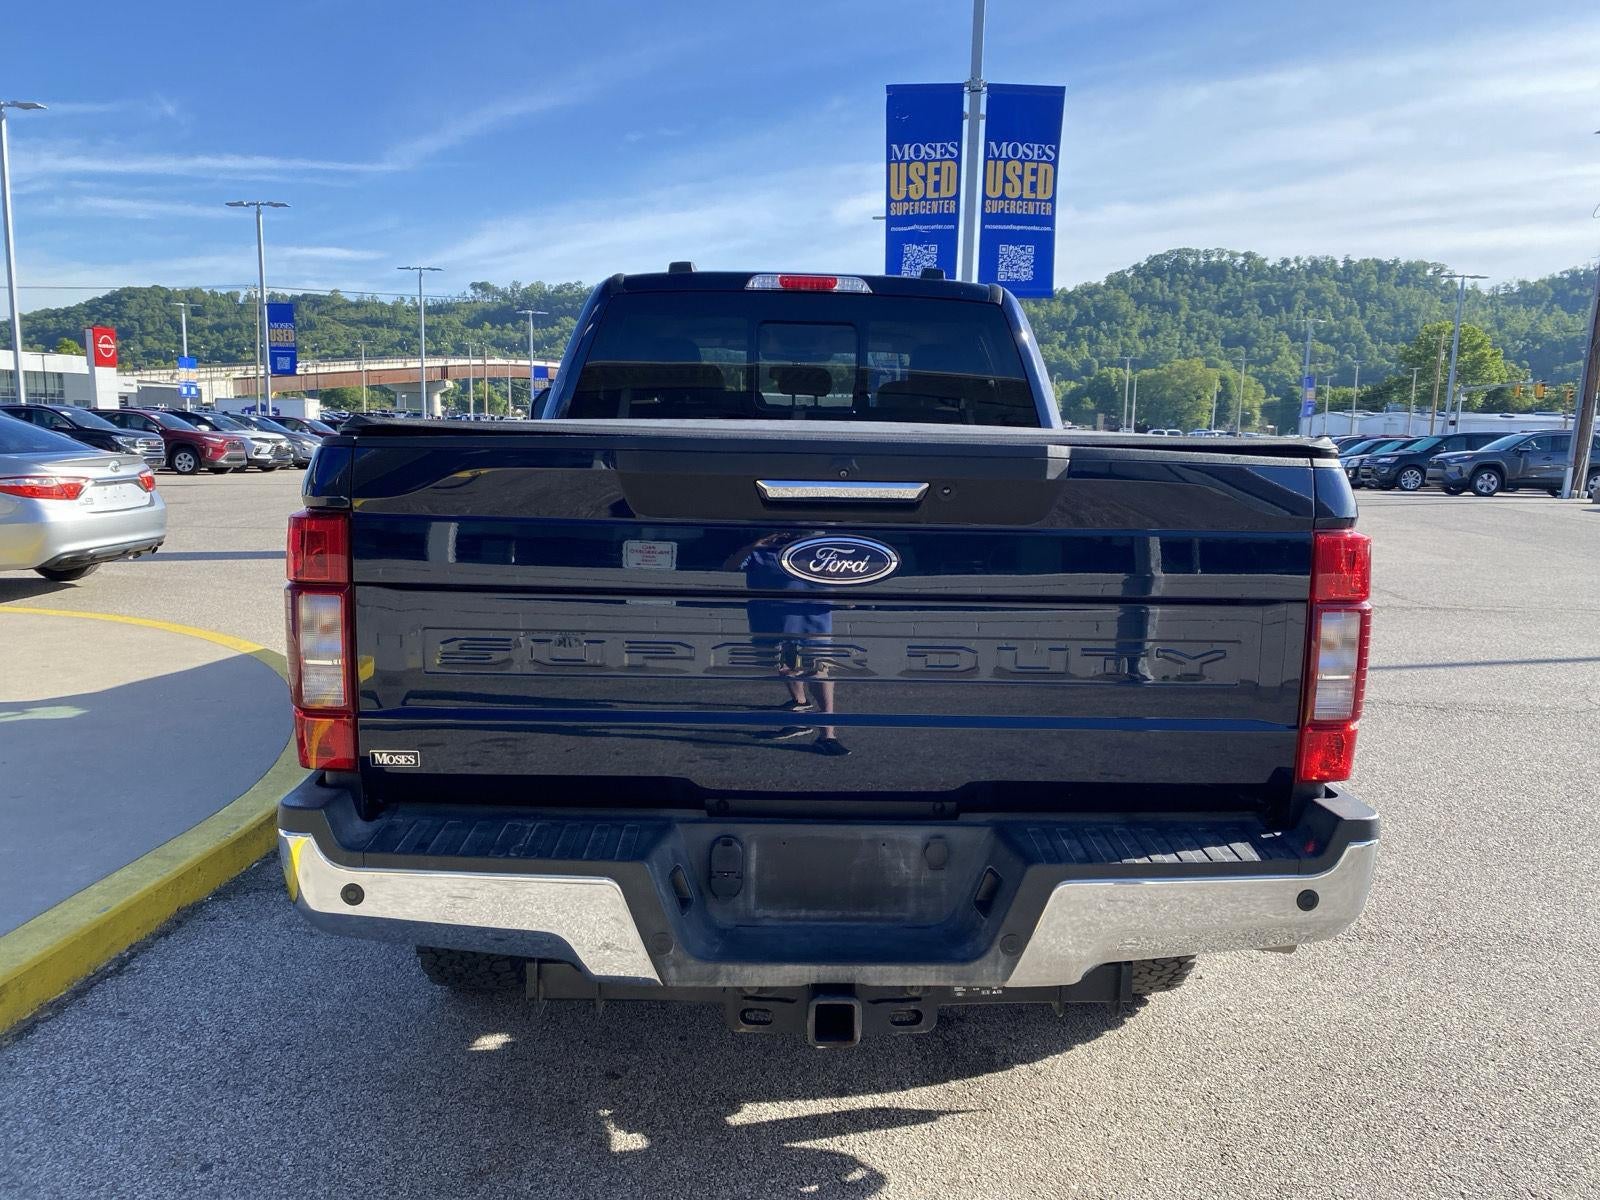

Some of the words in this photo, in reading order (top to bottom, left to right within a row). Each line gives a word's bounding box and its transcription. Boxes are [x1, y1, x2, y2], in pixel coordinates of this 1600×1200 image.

[891, 142, 959, 161] MOSES
[988, 142, 1056, 161] MOSES
[890, 161, 958, 200] USED
[985, 161, 1055, 200] USED
[890, 201, 956, 216] SUPERCENTER
[985, 201, 1052, 216] SUPERCENTER
[270, 329, 295, 342] USED
[809, 547, 871, 573] Ford
[436, 635, 868, 677] SUPER
[906, 643, 1228, 682] DUTY
[374, 752, 416, 765] MOSES
